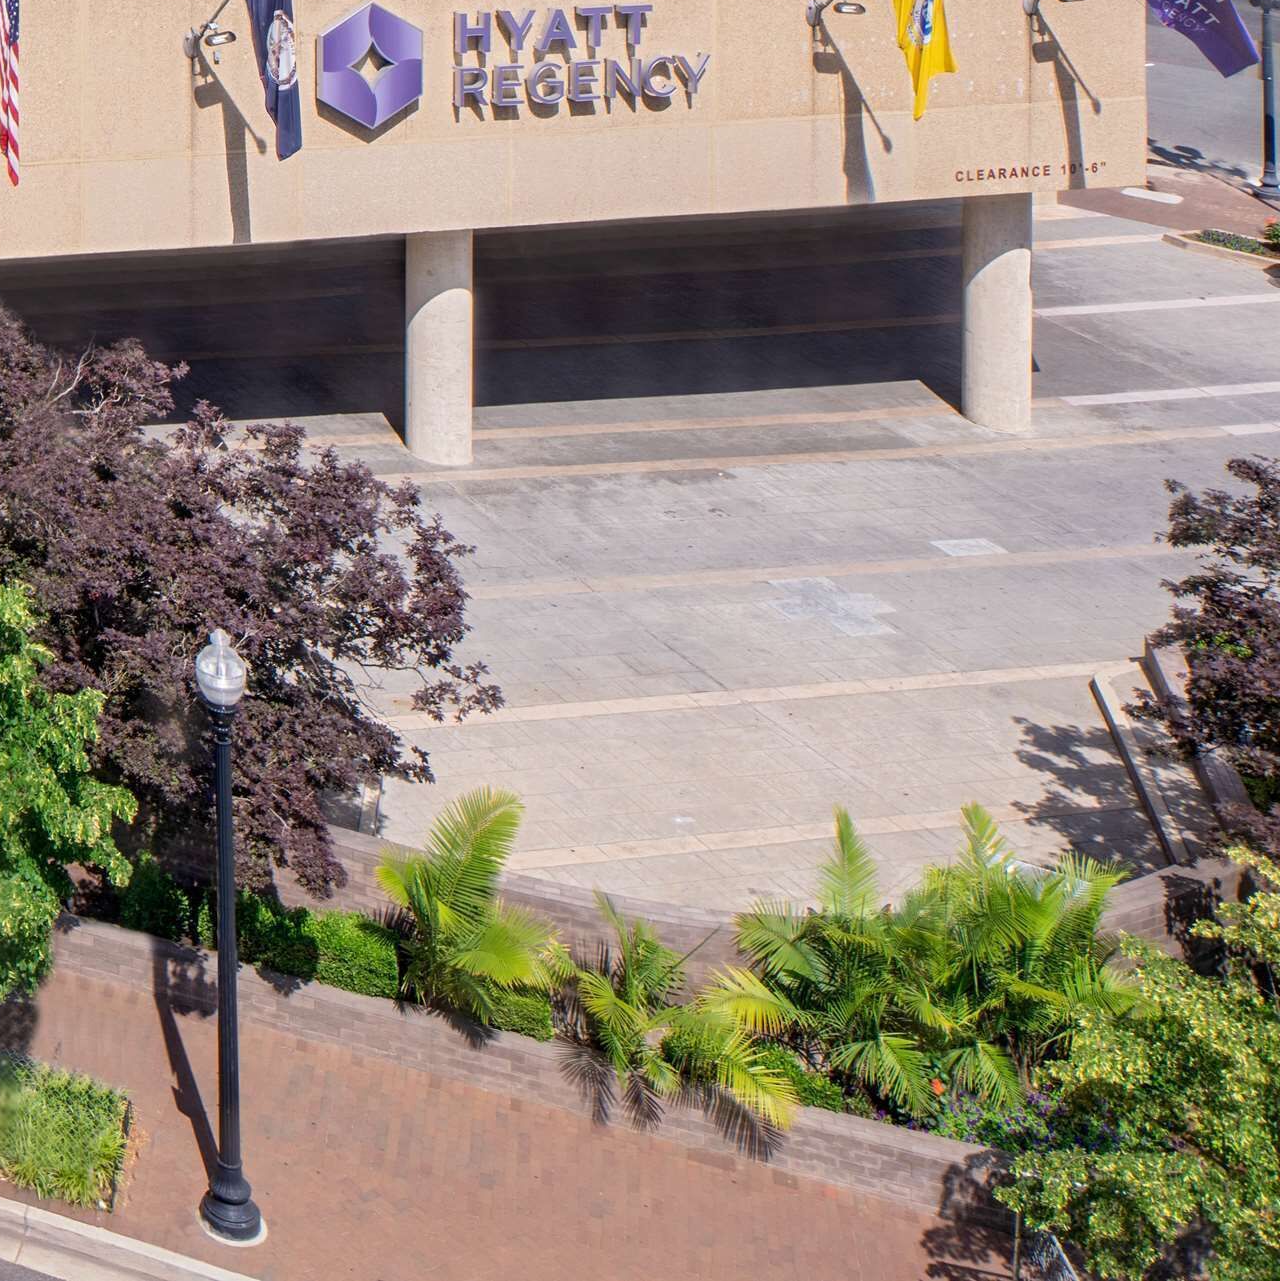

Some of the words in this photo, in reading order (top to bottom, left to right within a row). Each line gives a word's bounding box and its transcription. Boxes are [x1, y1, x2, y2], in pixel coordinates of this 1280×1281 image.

[453, 4, 653, 55] HYATT
[452, 52, 711, 108] REGENCY
[954, 164, 1052, 183] CLEARANCE
